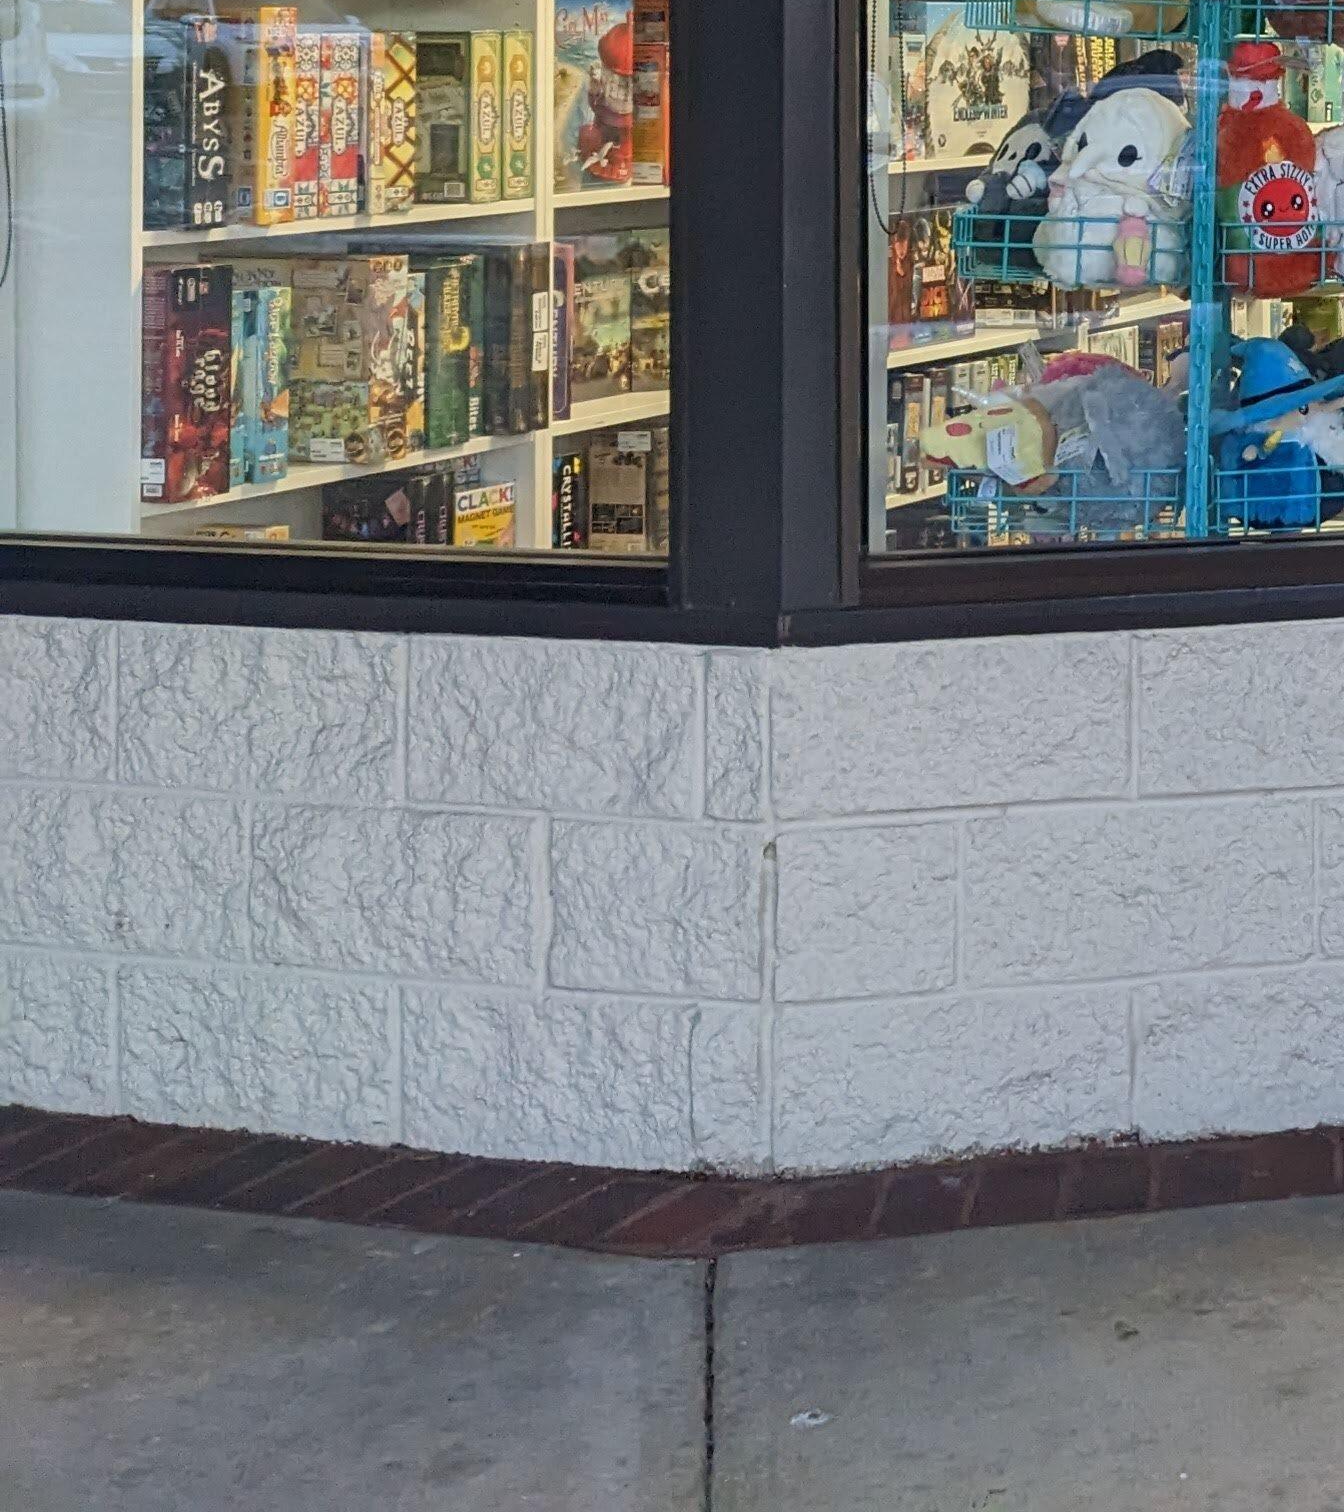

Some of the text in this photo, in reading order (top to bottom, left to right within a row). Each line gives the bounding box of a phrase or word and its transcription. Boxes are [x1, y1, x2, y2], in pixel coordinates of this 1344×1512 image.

[198, 68, 226, 182] ABYSS
[295, 106, 306, 148] AZUL
[334, 105, 345, 146] AZUL
[394, 105, 403, 139] AZUL
[481, 100, 491, 135] AZUL
[513, 98, 524, 134] AZUL
[268, 118, 289, 177] Alhambra
[1244, 165, 1277, 196] EXTRA
[1258, 233, 1293, 250] SUPER
[468, 396, 481, 432] Bites
[457, 509, 491, 523] MAGNET
[561, 464, 572, 550] CRYSTALLI
